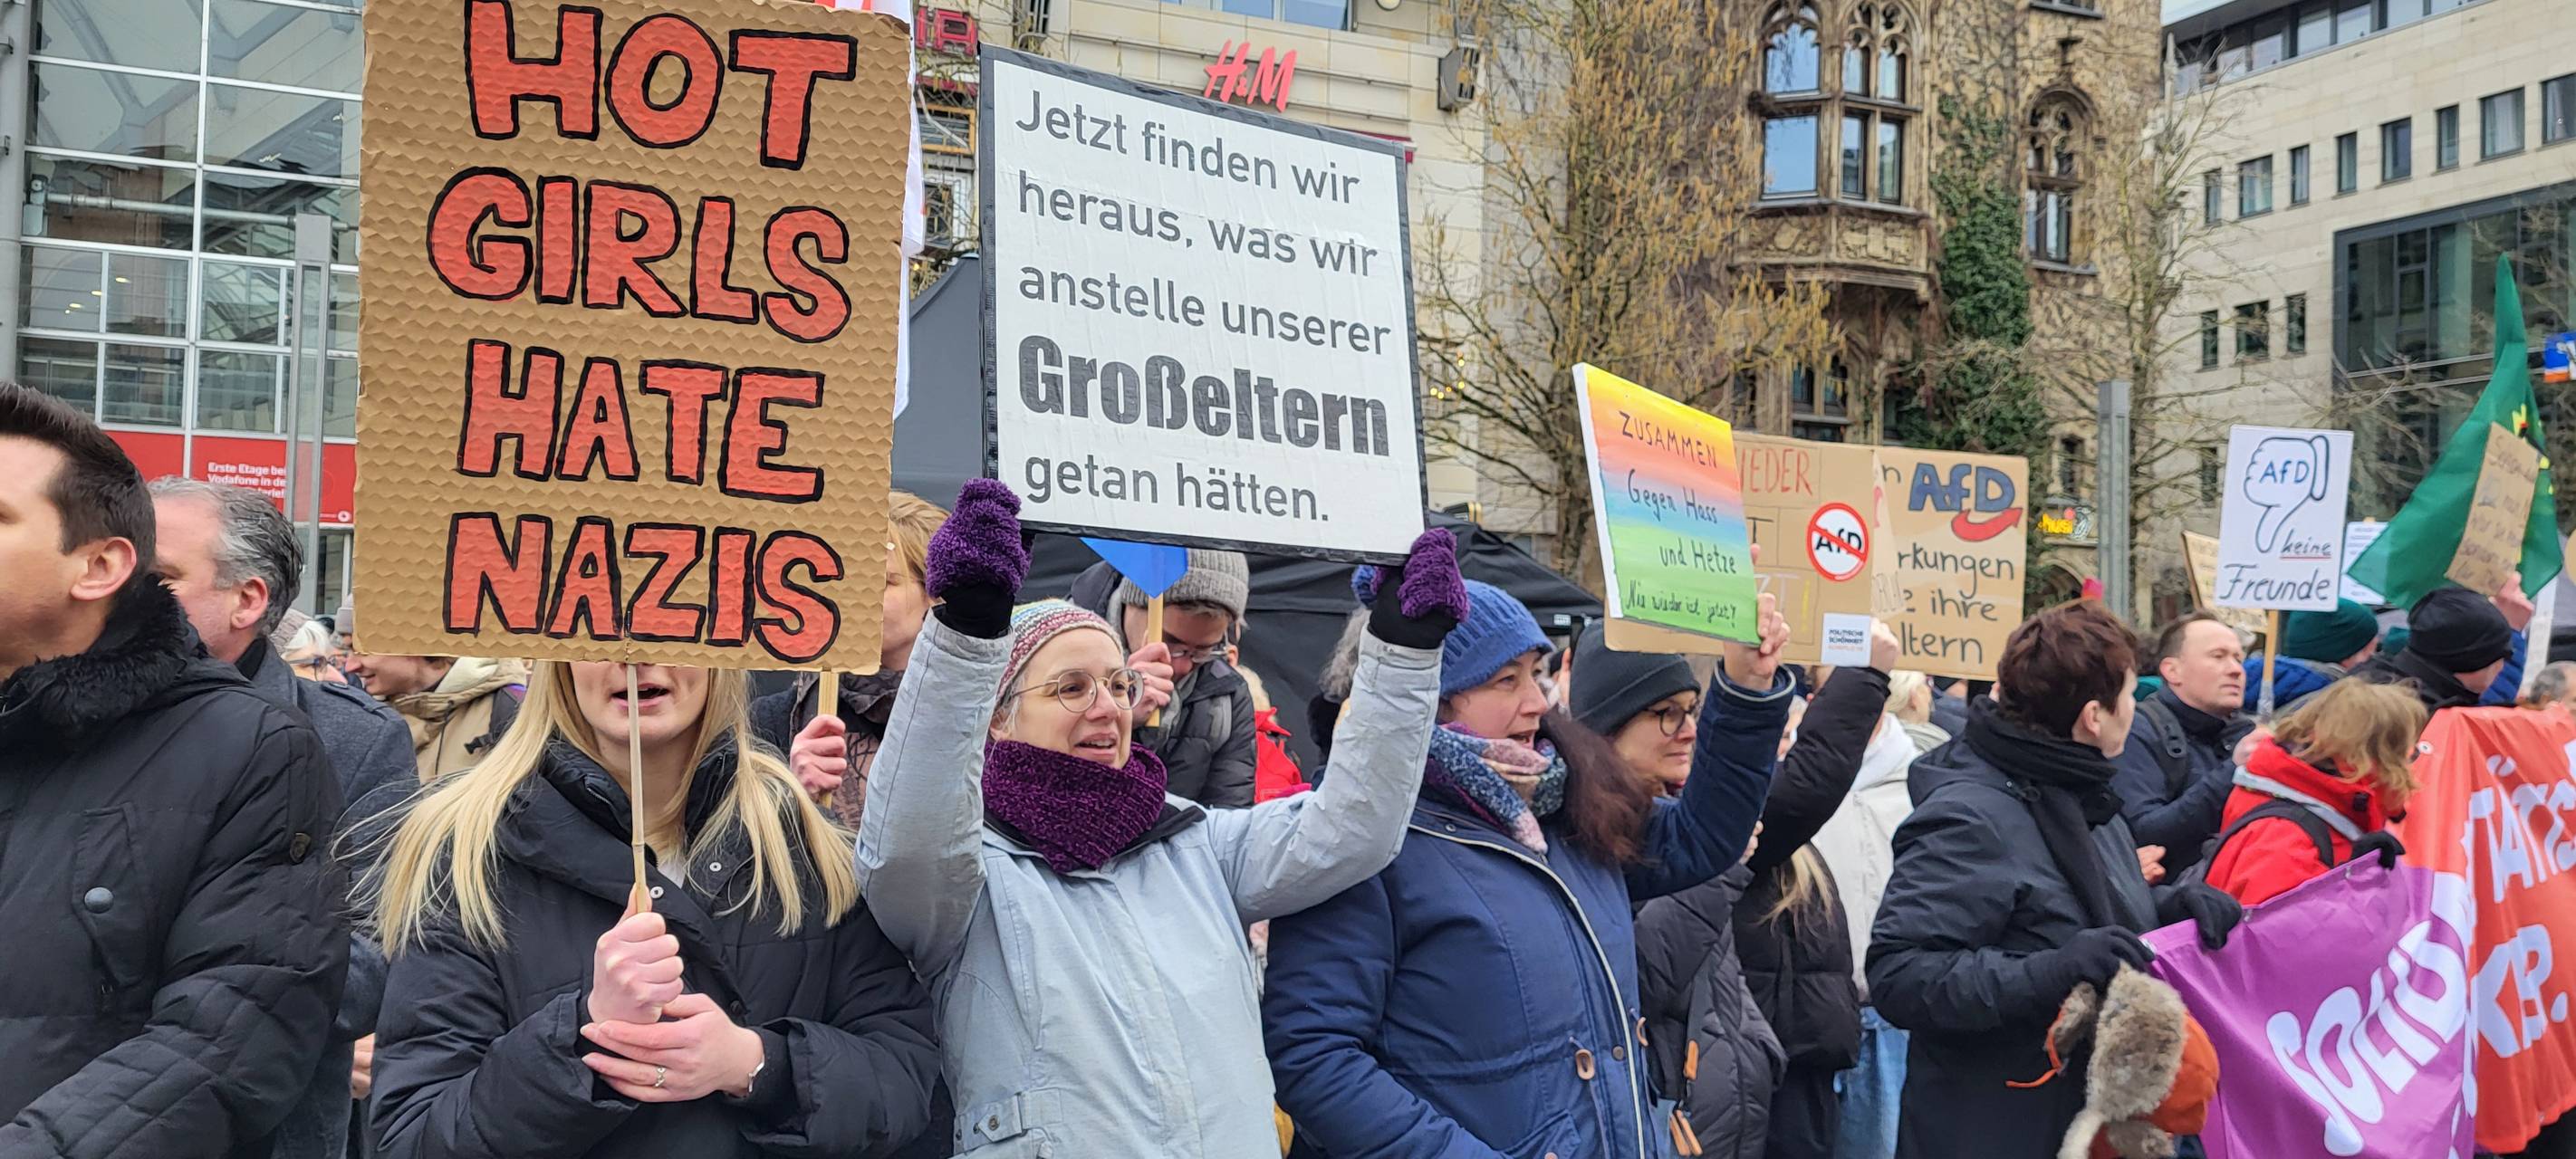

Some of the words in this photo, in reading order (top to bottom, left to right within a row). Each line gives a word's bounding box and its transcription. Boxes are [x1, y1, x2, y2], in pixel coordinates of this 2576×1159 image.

[464, 0, 857, 169] HOT
[1204, 39, 1297, 113] H&M
[1016, 91, 1127, 154] Jetzt
[1142, 122, 1276, 189] finden
[1292, 162, 1360, 204] wir
[1020, 170, 1193, 248] heraus,
[1208, 219, 1296, 263] was
[1310, 238, 1378, 277] wir
[427, 168, 851, 342] GIRLS
[1020, 266, 1205, 327] anstelle
[1223, 301, 1391, 354] unserer
[457, 338, 824, 503] HATE
[1019, 335, 1389, 456] Großeltern
[1619, 411, 1717, 468] ZUSAMMEN
[1025, 455, 1158, 503] getan
[1177, 463, 1330, 522] hätten.
[1628, 469, 1677, 522] Gegen
[1683, 487, 1718, 524] Hass
[1736, 448, 1812, 495] IEDER
[1908, 463, 2015, 512] AfD
[2259, 460, 2310, 484] AfD
[1659, 537, 1687, 567] und
[1690, 539, 1736, 574] Hetze
[1815, 527, 1862, 554] AfD
[2281, 528, 2332, 556] keine
[444, 512, 844, 663] NAZIS
[1931, 589, 1998, 621] ihre
[2219, 562, 2331, 601] Freunde
[1900, 621, 1983, 665] ltern
